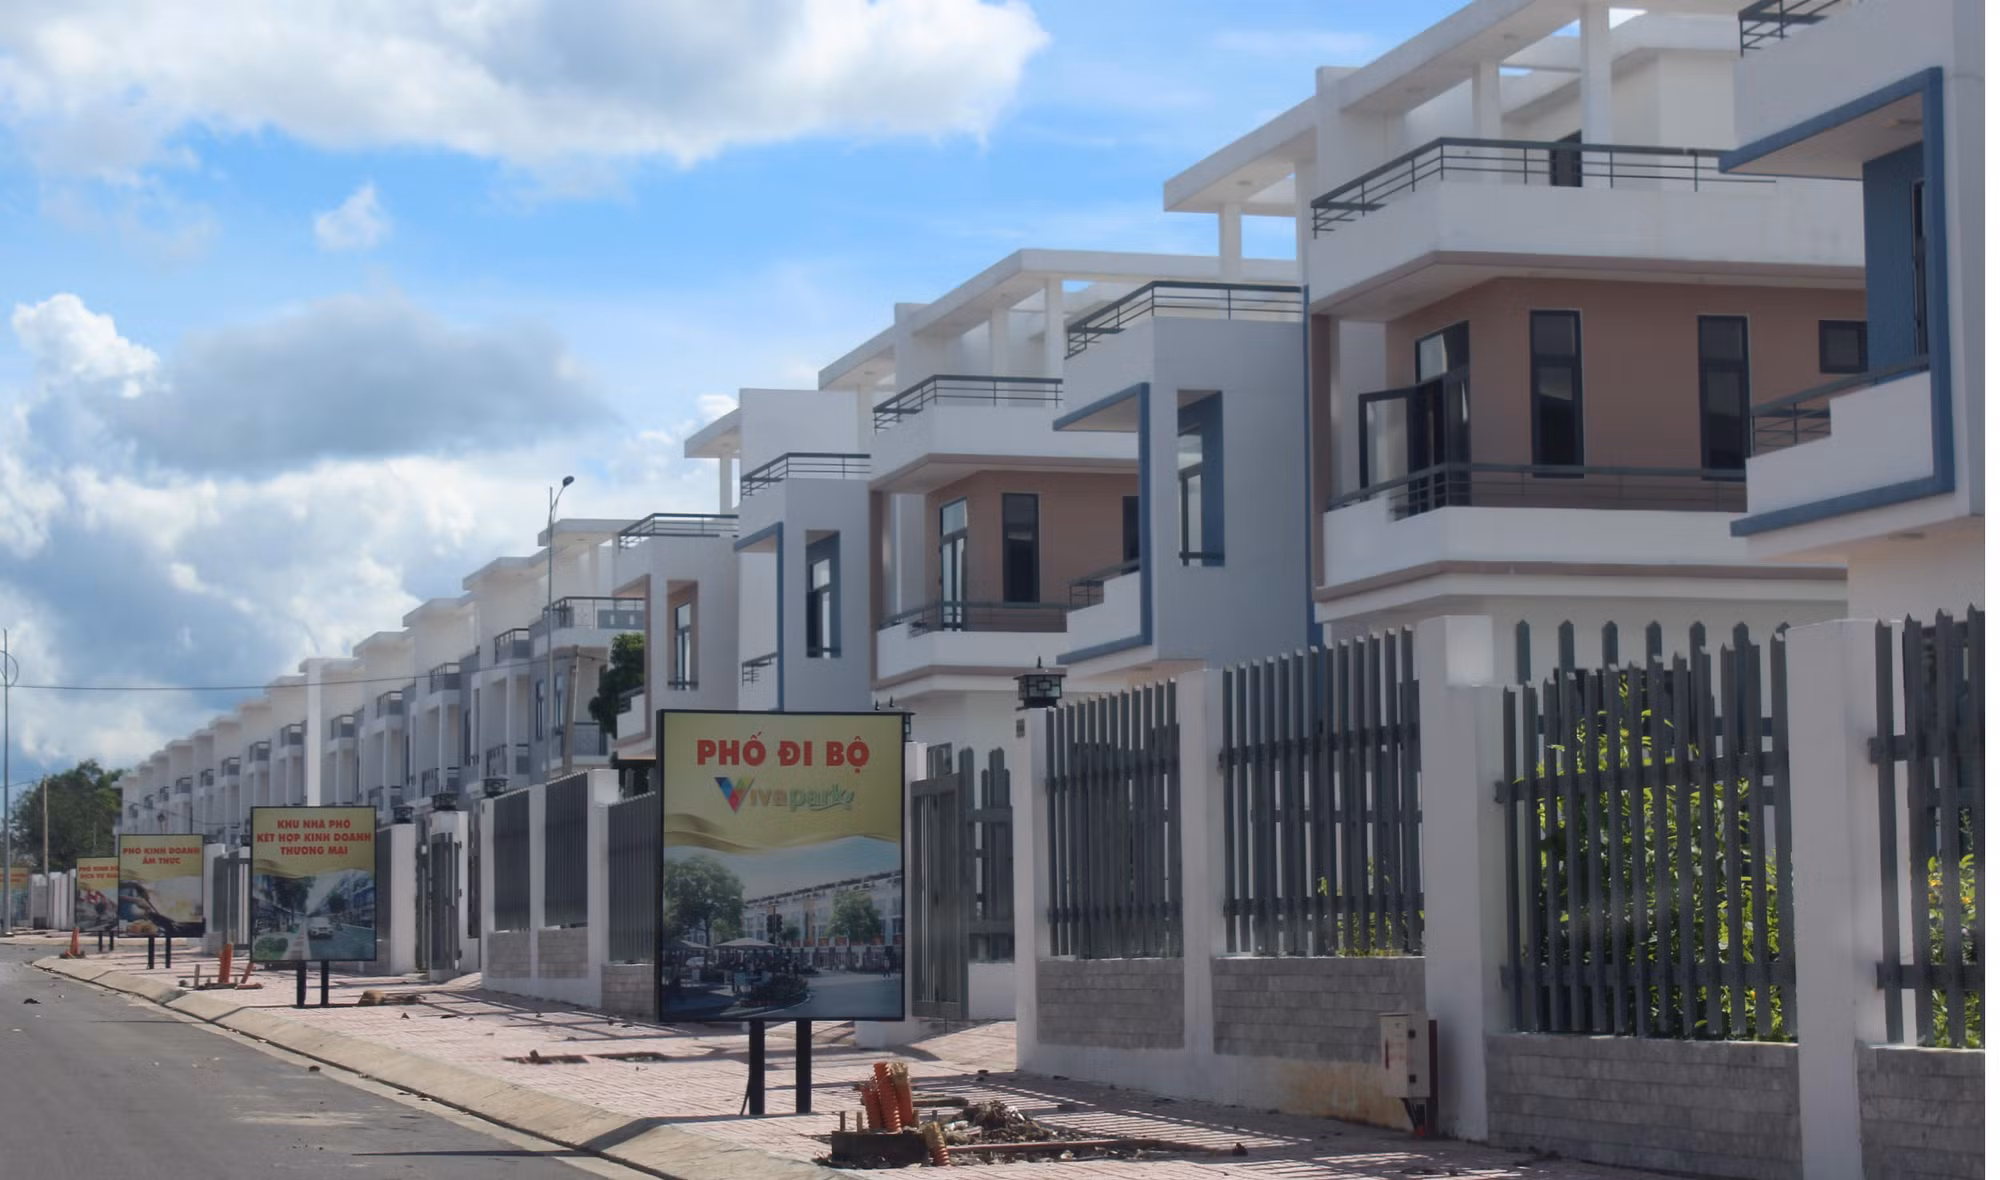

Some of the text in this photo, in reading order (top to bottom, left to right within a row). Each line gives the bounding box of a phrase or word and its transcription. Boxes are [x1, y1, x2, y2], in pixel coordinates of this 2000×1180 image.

[696, 731, 870, 774] PHỐ ĐI BỘ
[277, 819, 300, 829] KHU
[303, 832, 330, 842] KINH
[333, 831, 372, 842] DOANH
